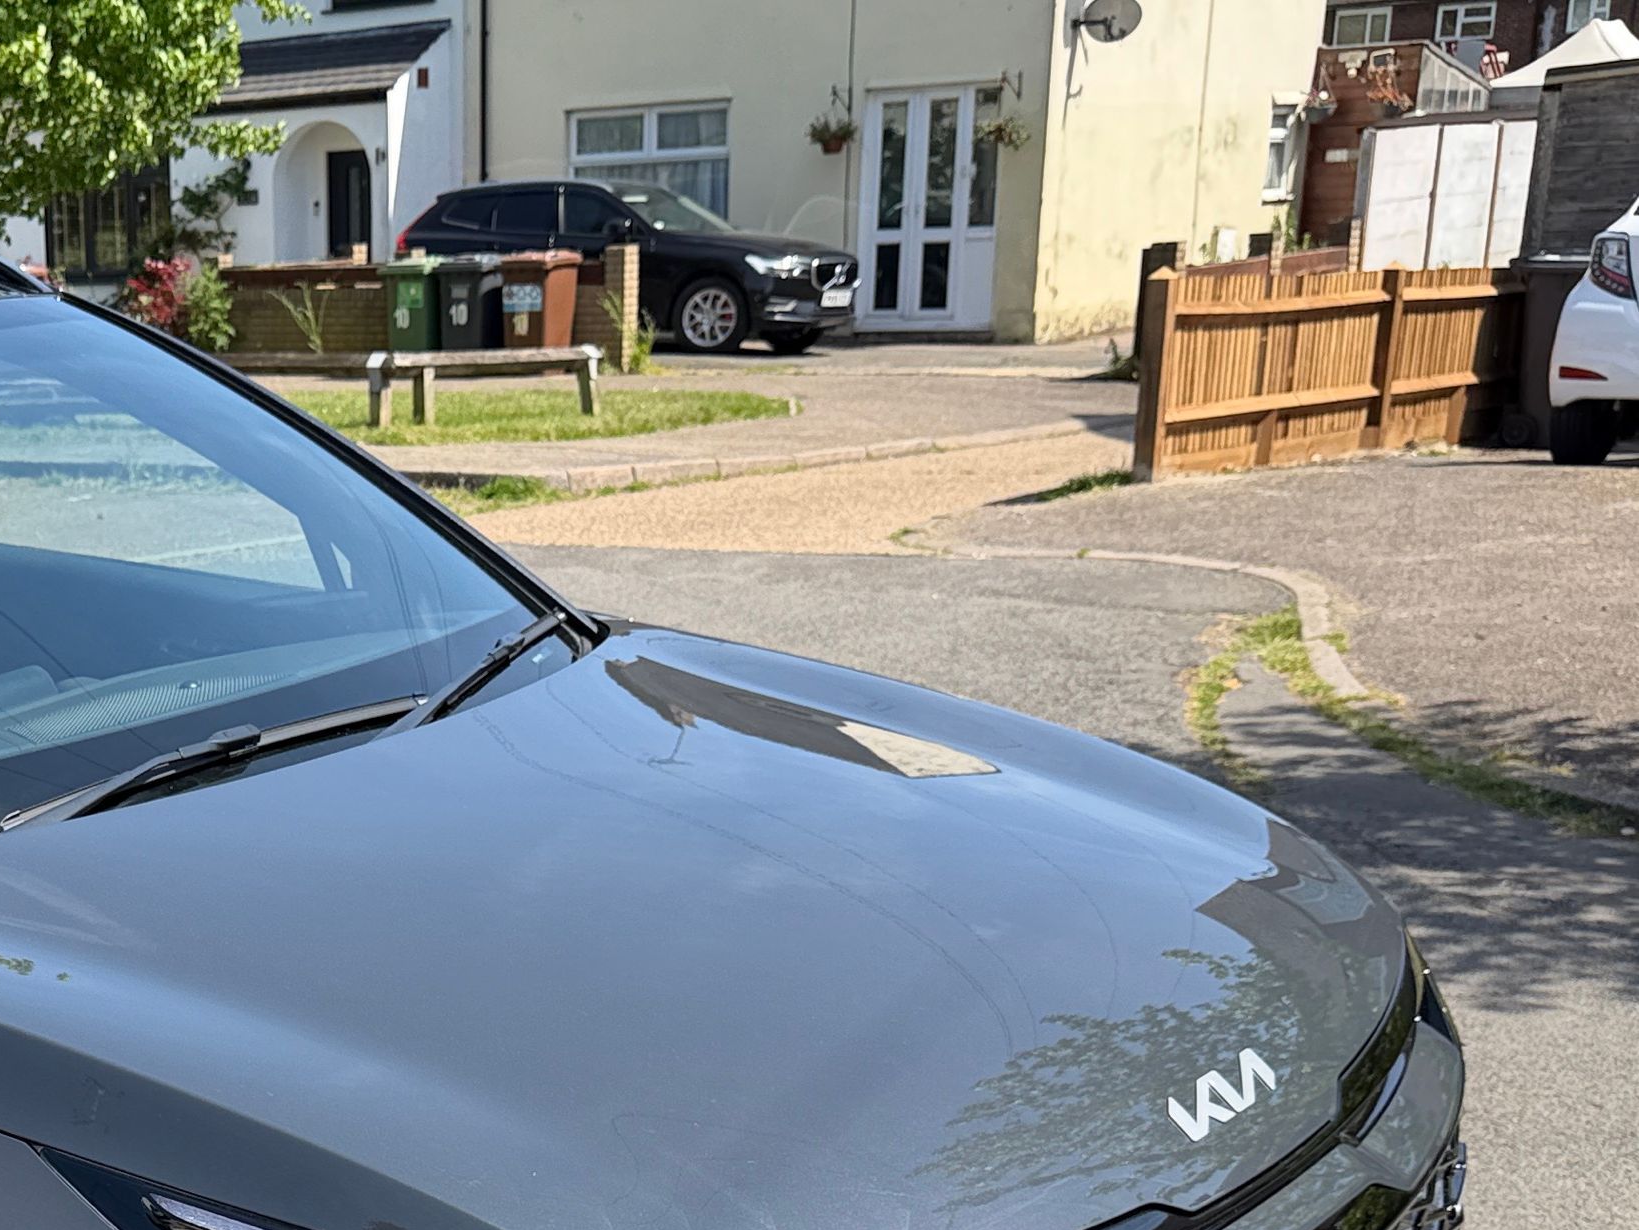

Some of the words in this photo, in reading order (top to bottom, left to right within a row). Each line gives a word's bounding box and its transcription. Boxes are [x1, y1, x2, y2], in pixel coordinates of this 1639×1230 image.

[393, 306, 410, 329] 10
[449, 302, 468, 326] 10
[512, 313, 529, 336] 10
[1166, 1047, 1277, 1142] KIA
